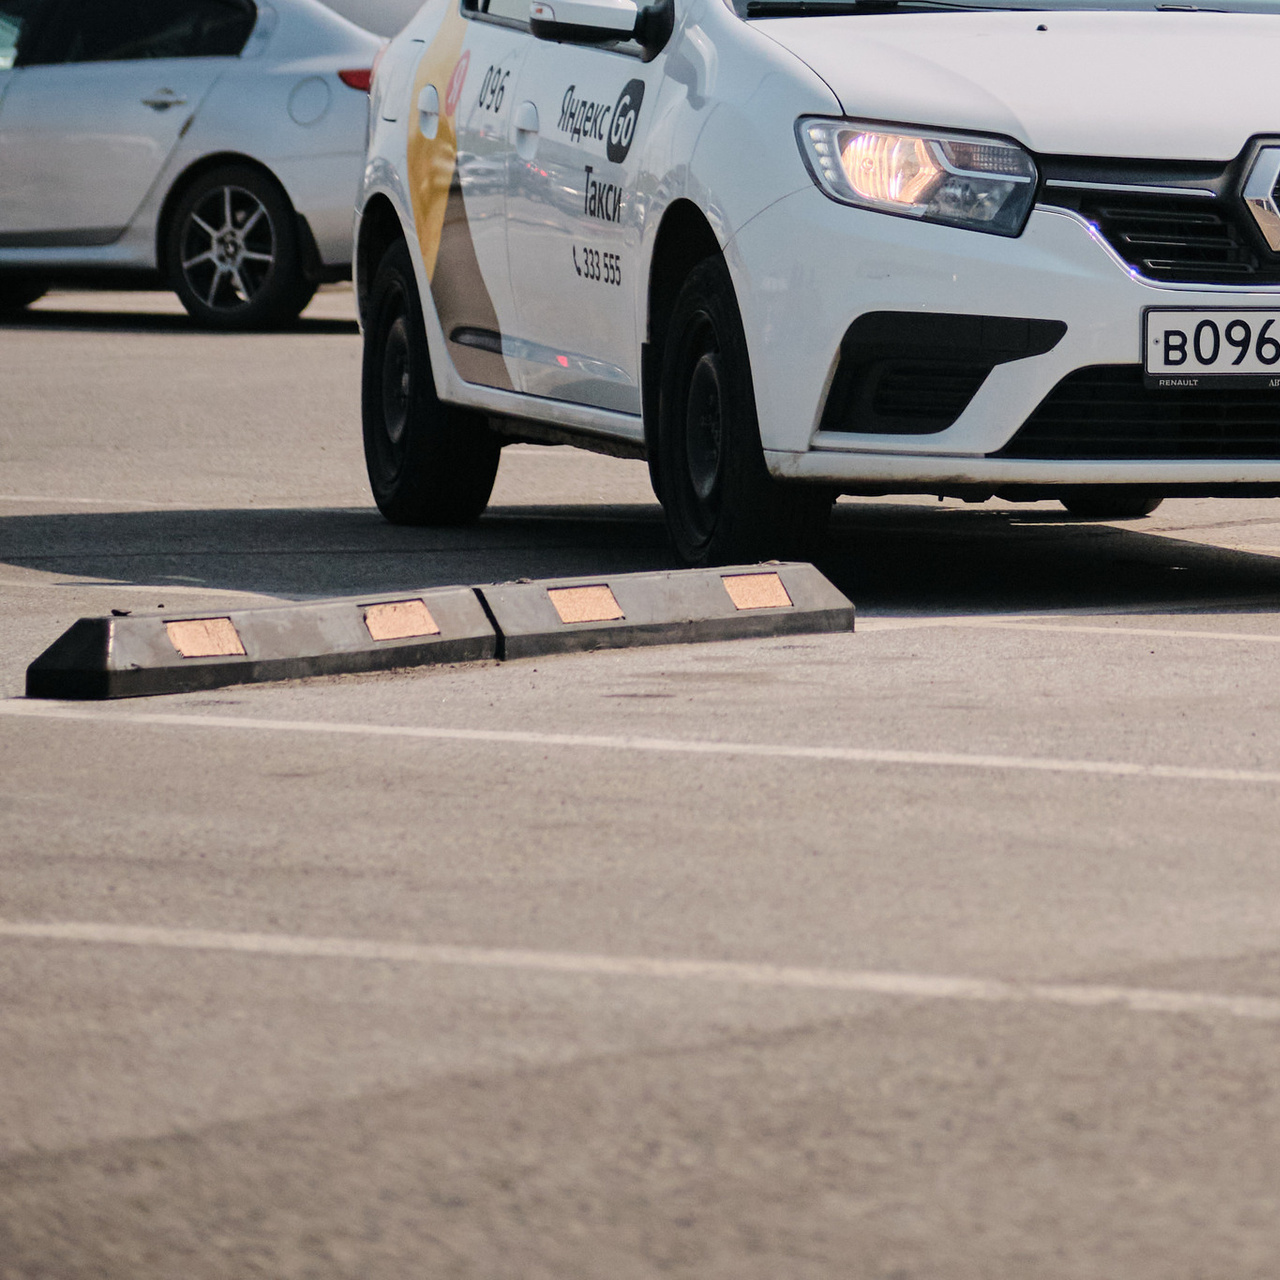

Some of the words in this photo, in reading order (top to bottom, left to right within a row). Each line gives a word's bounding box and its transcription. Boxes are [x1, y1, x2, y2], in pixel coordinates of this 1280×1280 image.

[478, 64, 511, 114] 096
[557, 84, 610, 142] Яндекс
[612, 94, 636, 149] Go
[584, 165, 623, 224] Такси
[583, 247, 601, 282] 333
[603, 251, 622, 286] 555
[1159, 378, 1199, 387] RENAULT
